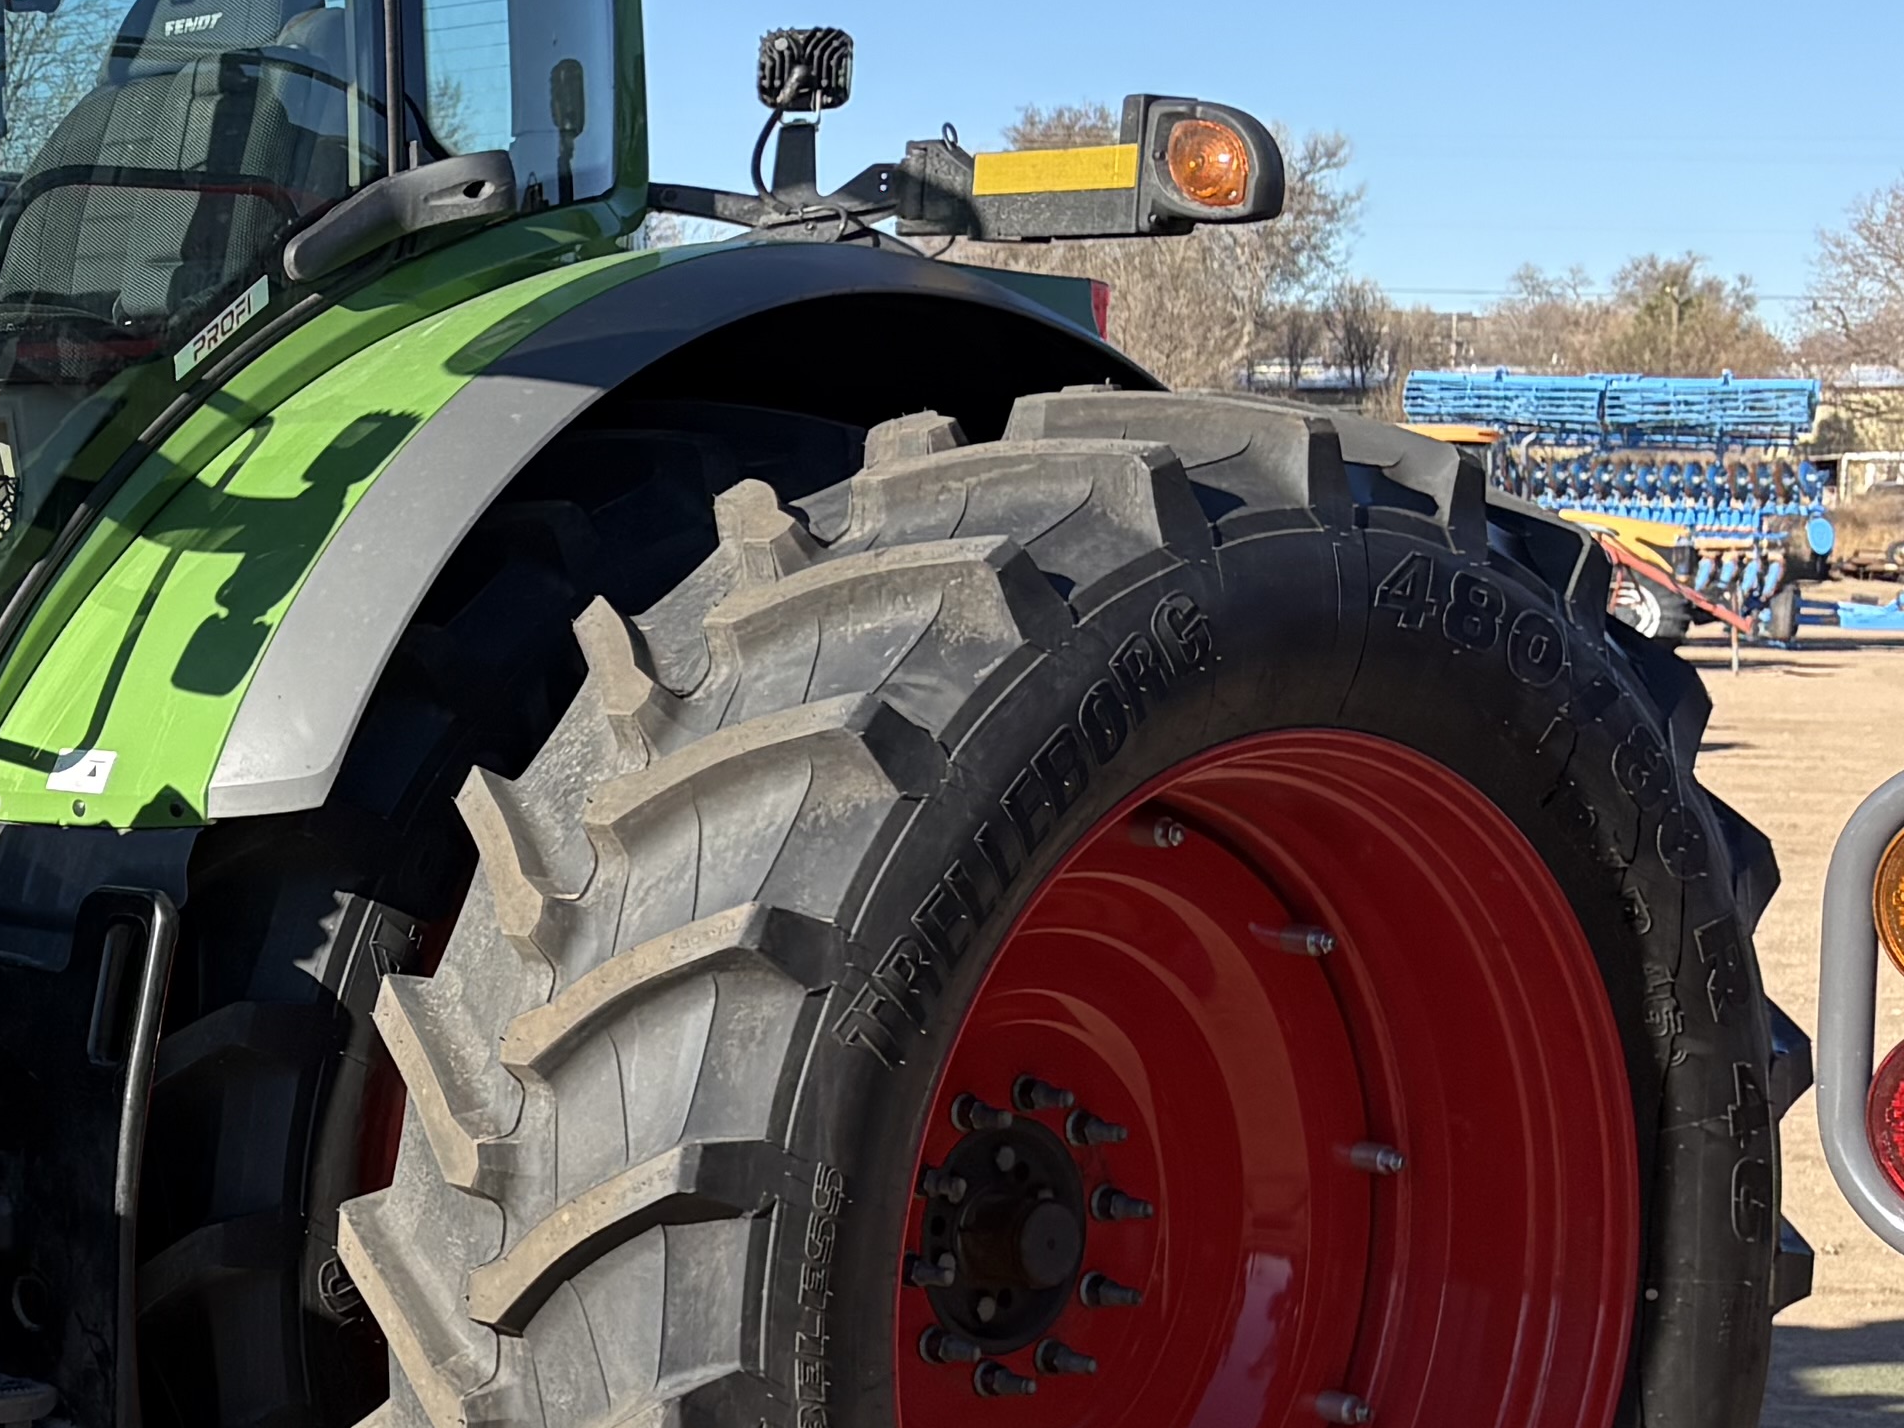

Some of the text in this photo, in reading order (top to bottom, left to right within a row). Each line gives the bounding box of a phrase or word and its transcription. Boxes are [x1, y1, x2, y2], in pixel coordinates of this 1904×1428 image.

[165, 12, 223, 37] FENDT
[193, 293, 254, 362] PROFI
[832, 588, 1215, 1070] TRELLEBORG
